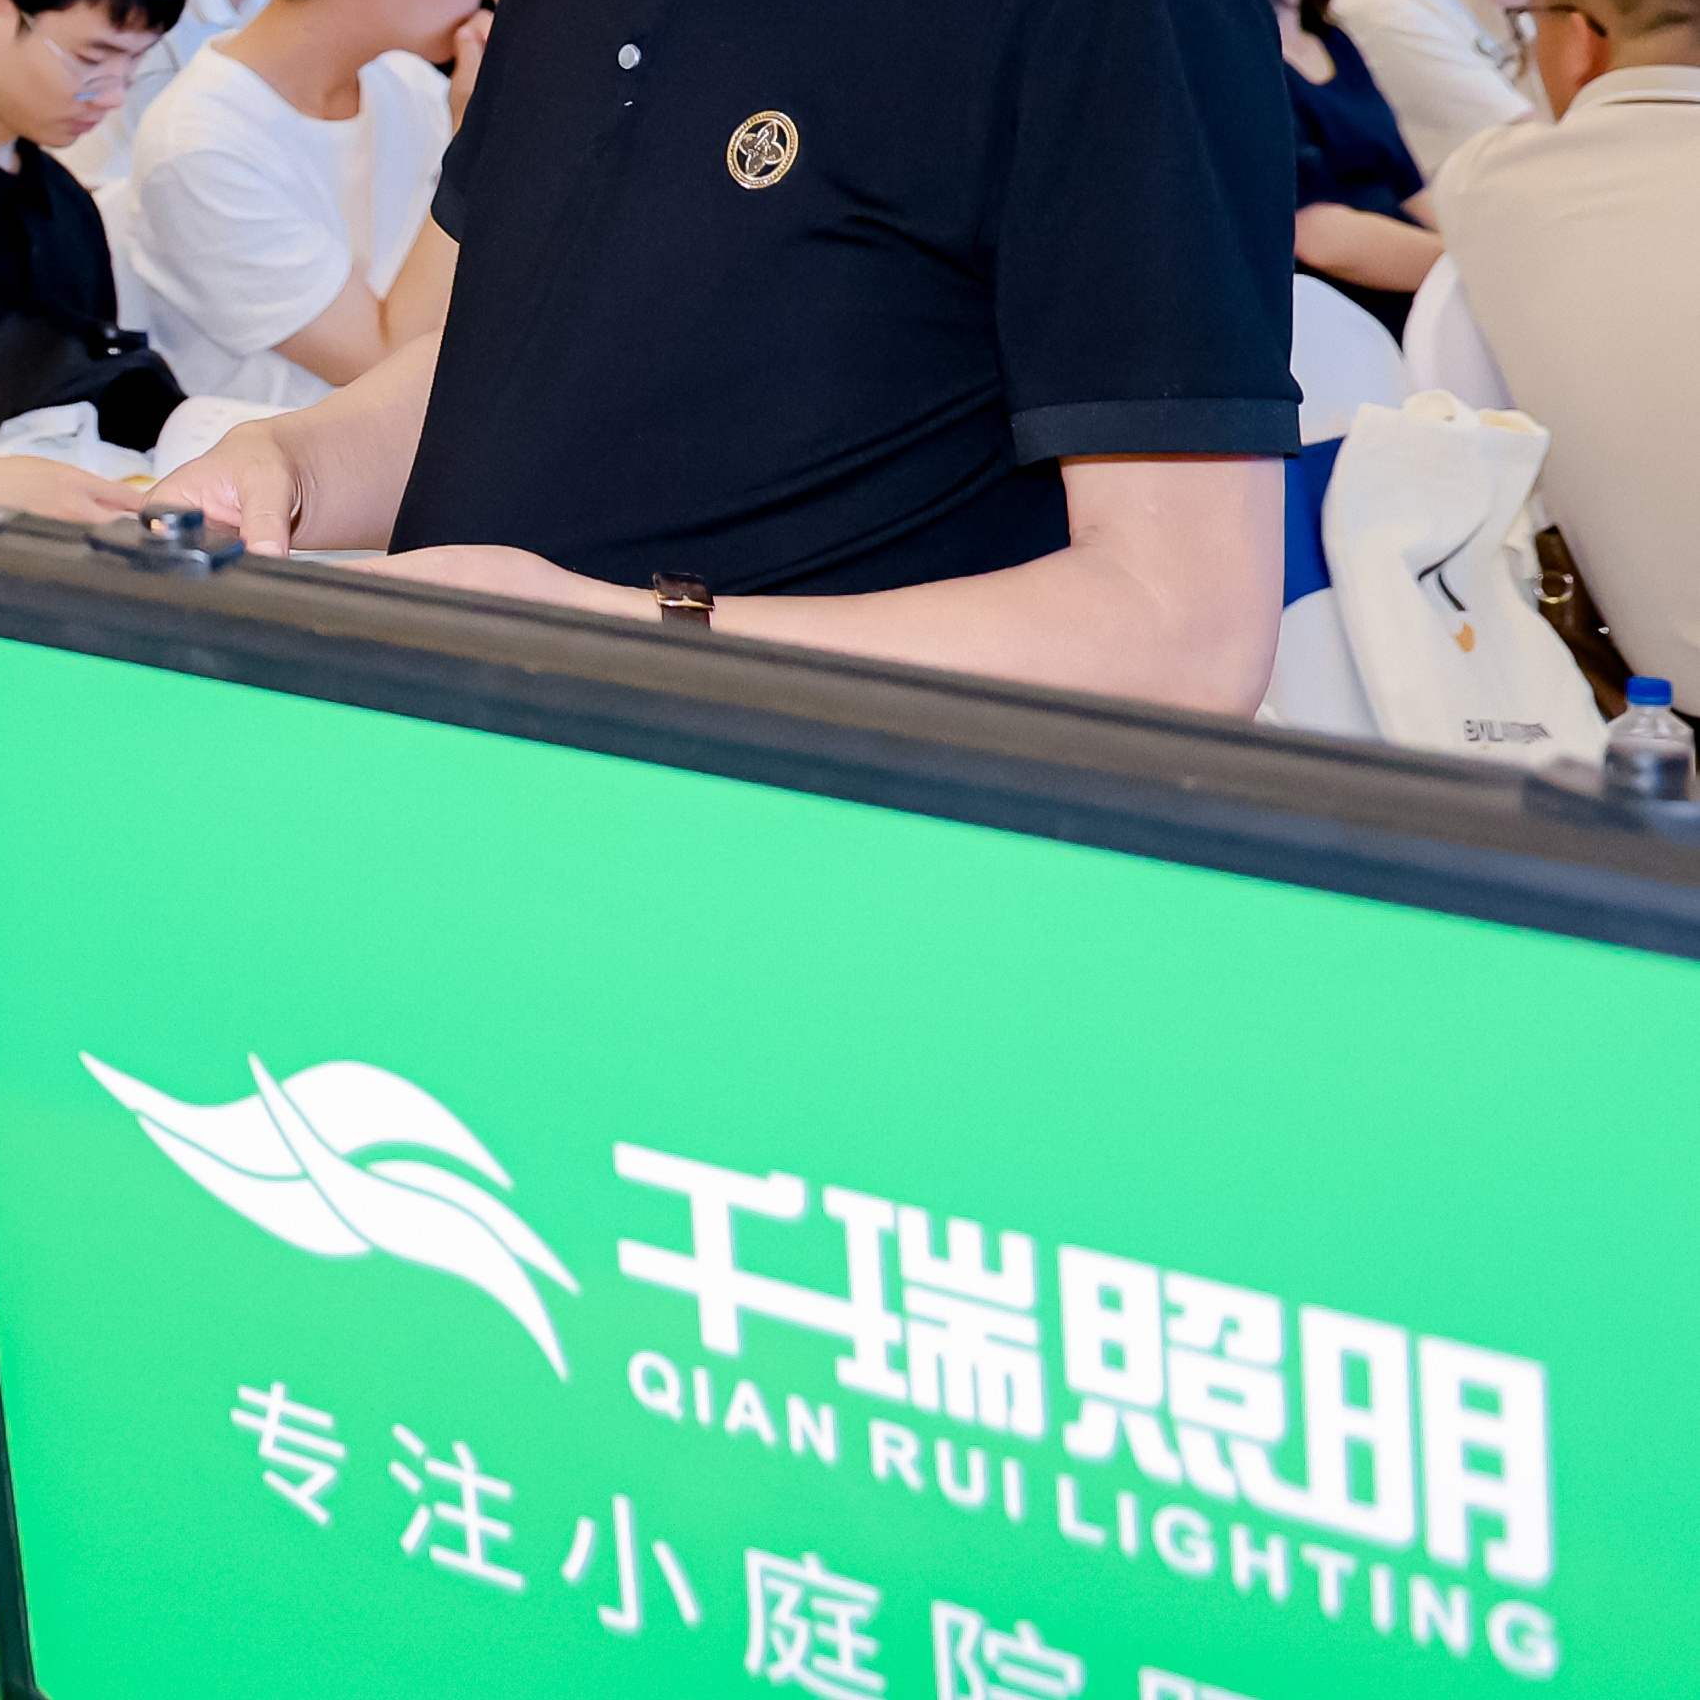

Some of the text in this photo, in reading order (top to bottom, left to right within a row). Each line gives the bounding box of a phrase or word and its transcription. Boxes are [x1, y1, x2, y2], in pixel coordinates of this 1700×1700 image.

[613, 1141, 1554, 1586] 千瑞照明
[627, 1350, 1561, 1679] QIAN RUI LIGHTING
[229, 1381, 1276, 1700] 专注小庭院
